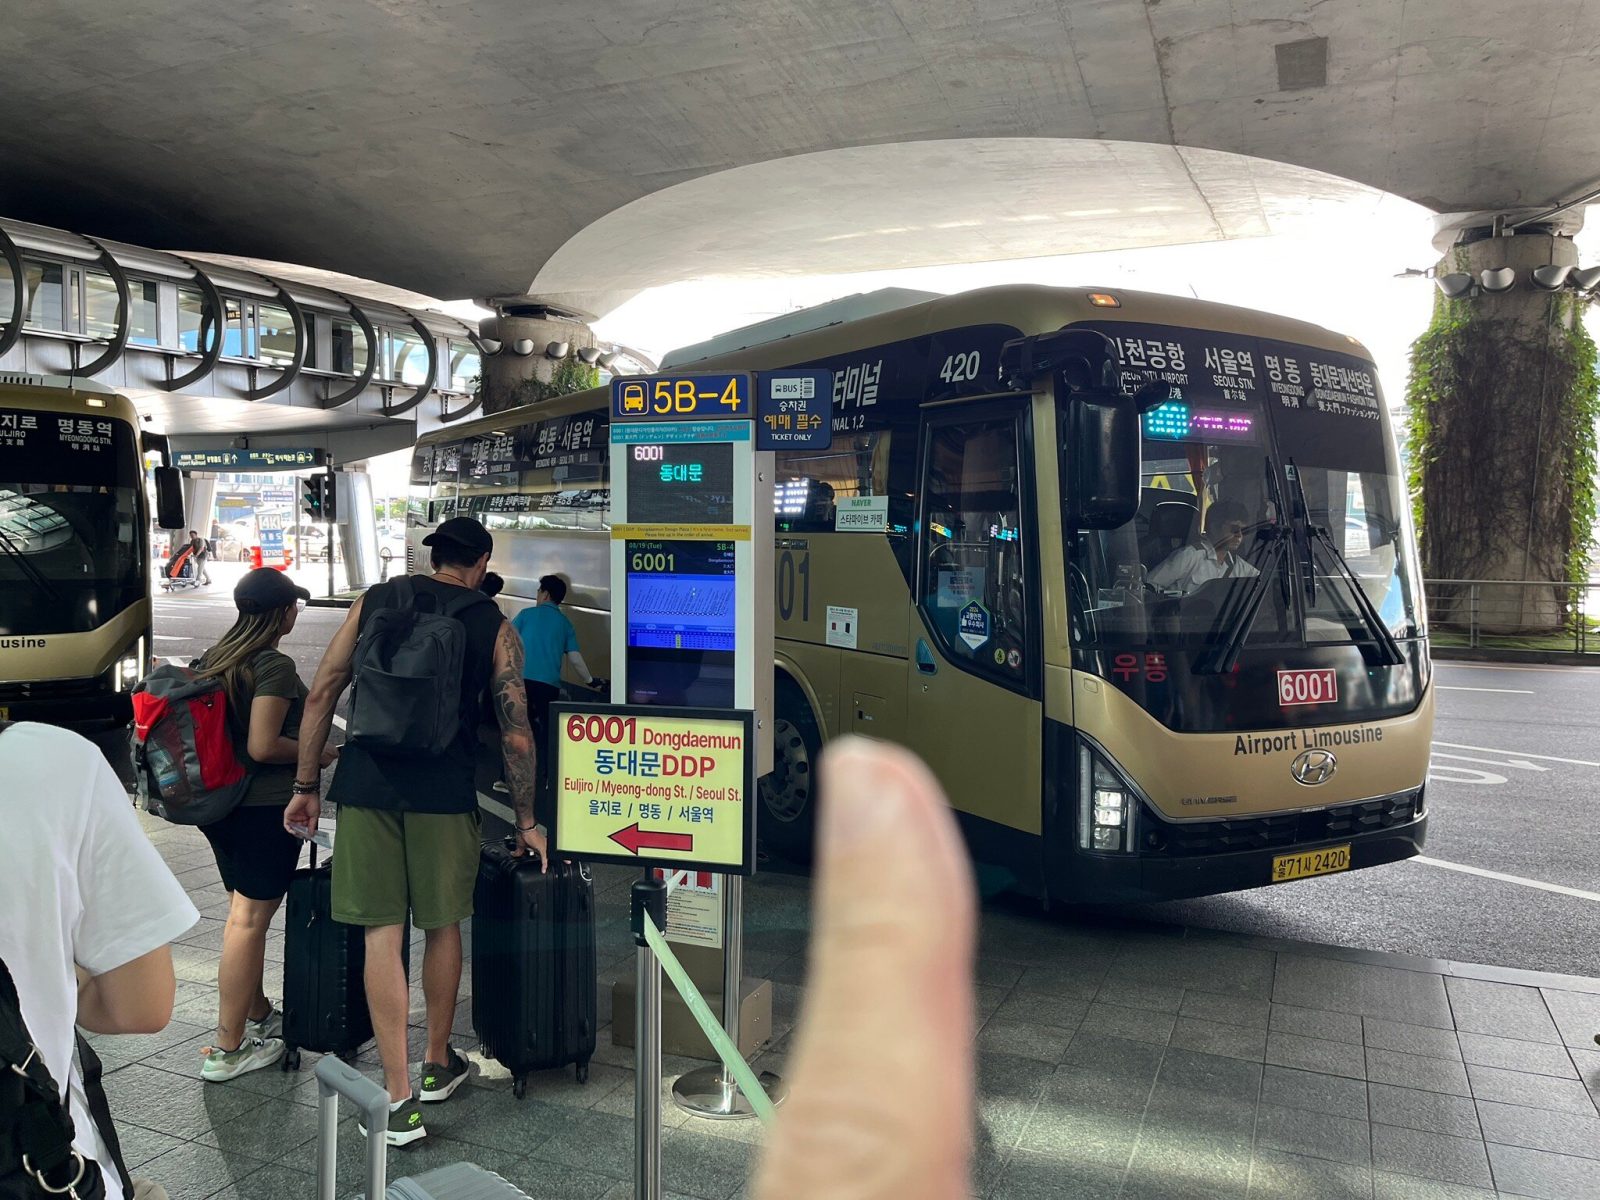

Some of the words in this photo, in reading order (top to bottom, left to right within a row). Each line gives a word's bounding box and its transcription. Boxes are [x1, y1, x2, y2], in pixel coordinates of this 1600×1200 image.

[940, 351, 980, 383] 420
[1205, 347, 1256, 378] 서울역
[1264, 355, 1300, 384] 명동
[1161, 372, 1189, 385] AIRPORT
[1213, 374, 1238, 388] SEOUL
[1239, 378, 1256, 390] STN.
[1309, 362, 1375, 397] 동대문패션타운
[654, 378, 741, 413] 5B-4
[779, 400, 806, 412] 승차권
[58, 419, 112, 437] 명동역
[764, 414, 791, 430] 예매
[797, 414, 822, 429] 필수
[634, 446, 663, 460] 6001
[660, 464, 702, 481] 동대문
[870, 512, 883, 525] 카페
[647, 542, 662, 550] (Tue)
[632, 553, 674, 571] 6001
[1, 637, 46, 648] usine
[1113, 653, 1168, 683] 우등
[1280, 673, 1335, 701] 6001
[567, 714, 637, 744] 6001
[643, 728, 741, 750] Dongdaemun
[1234, 732, 1297, 756] Airport
[1302, 725, 1383, 749] Limousine
[564, 777, 594, 795] Euljiro
[601, 780, 671, 800] Myeong-dong
[673, 785, 687, 799] St.
[696, 786, 725, 800] Seoul
[727, 788, 741, 802] St.
[589, 800, 622, 816] 을지로
[627, 802, 633, 818] /
[639, 803, 662, 819] 명동
[667, 805, 673, 821] /
[679, 805, 714, 823] 서울역
[1314, 850, 1346, 872] 2420
